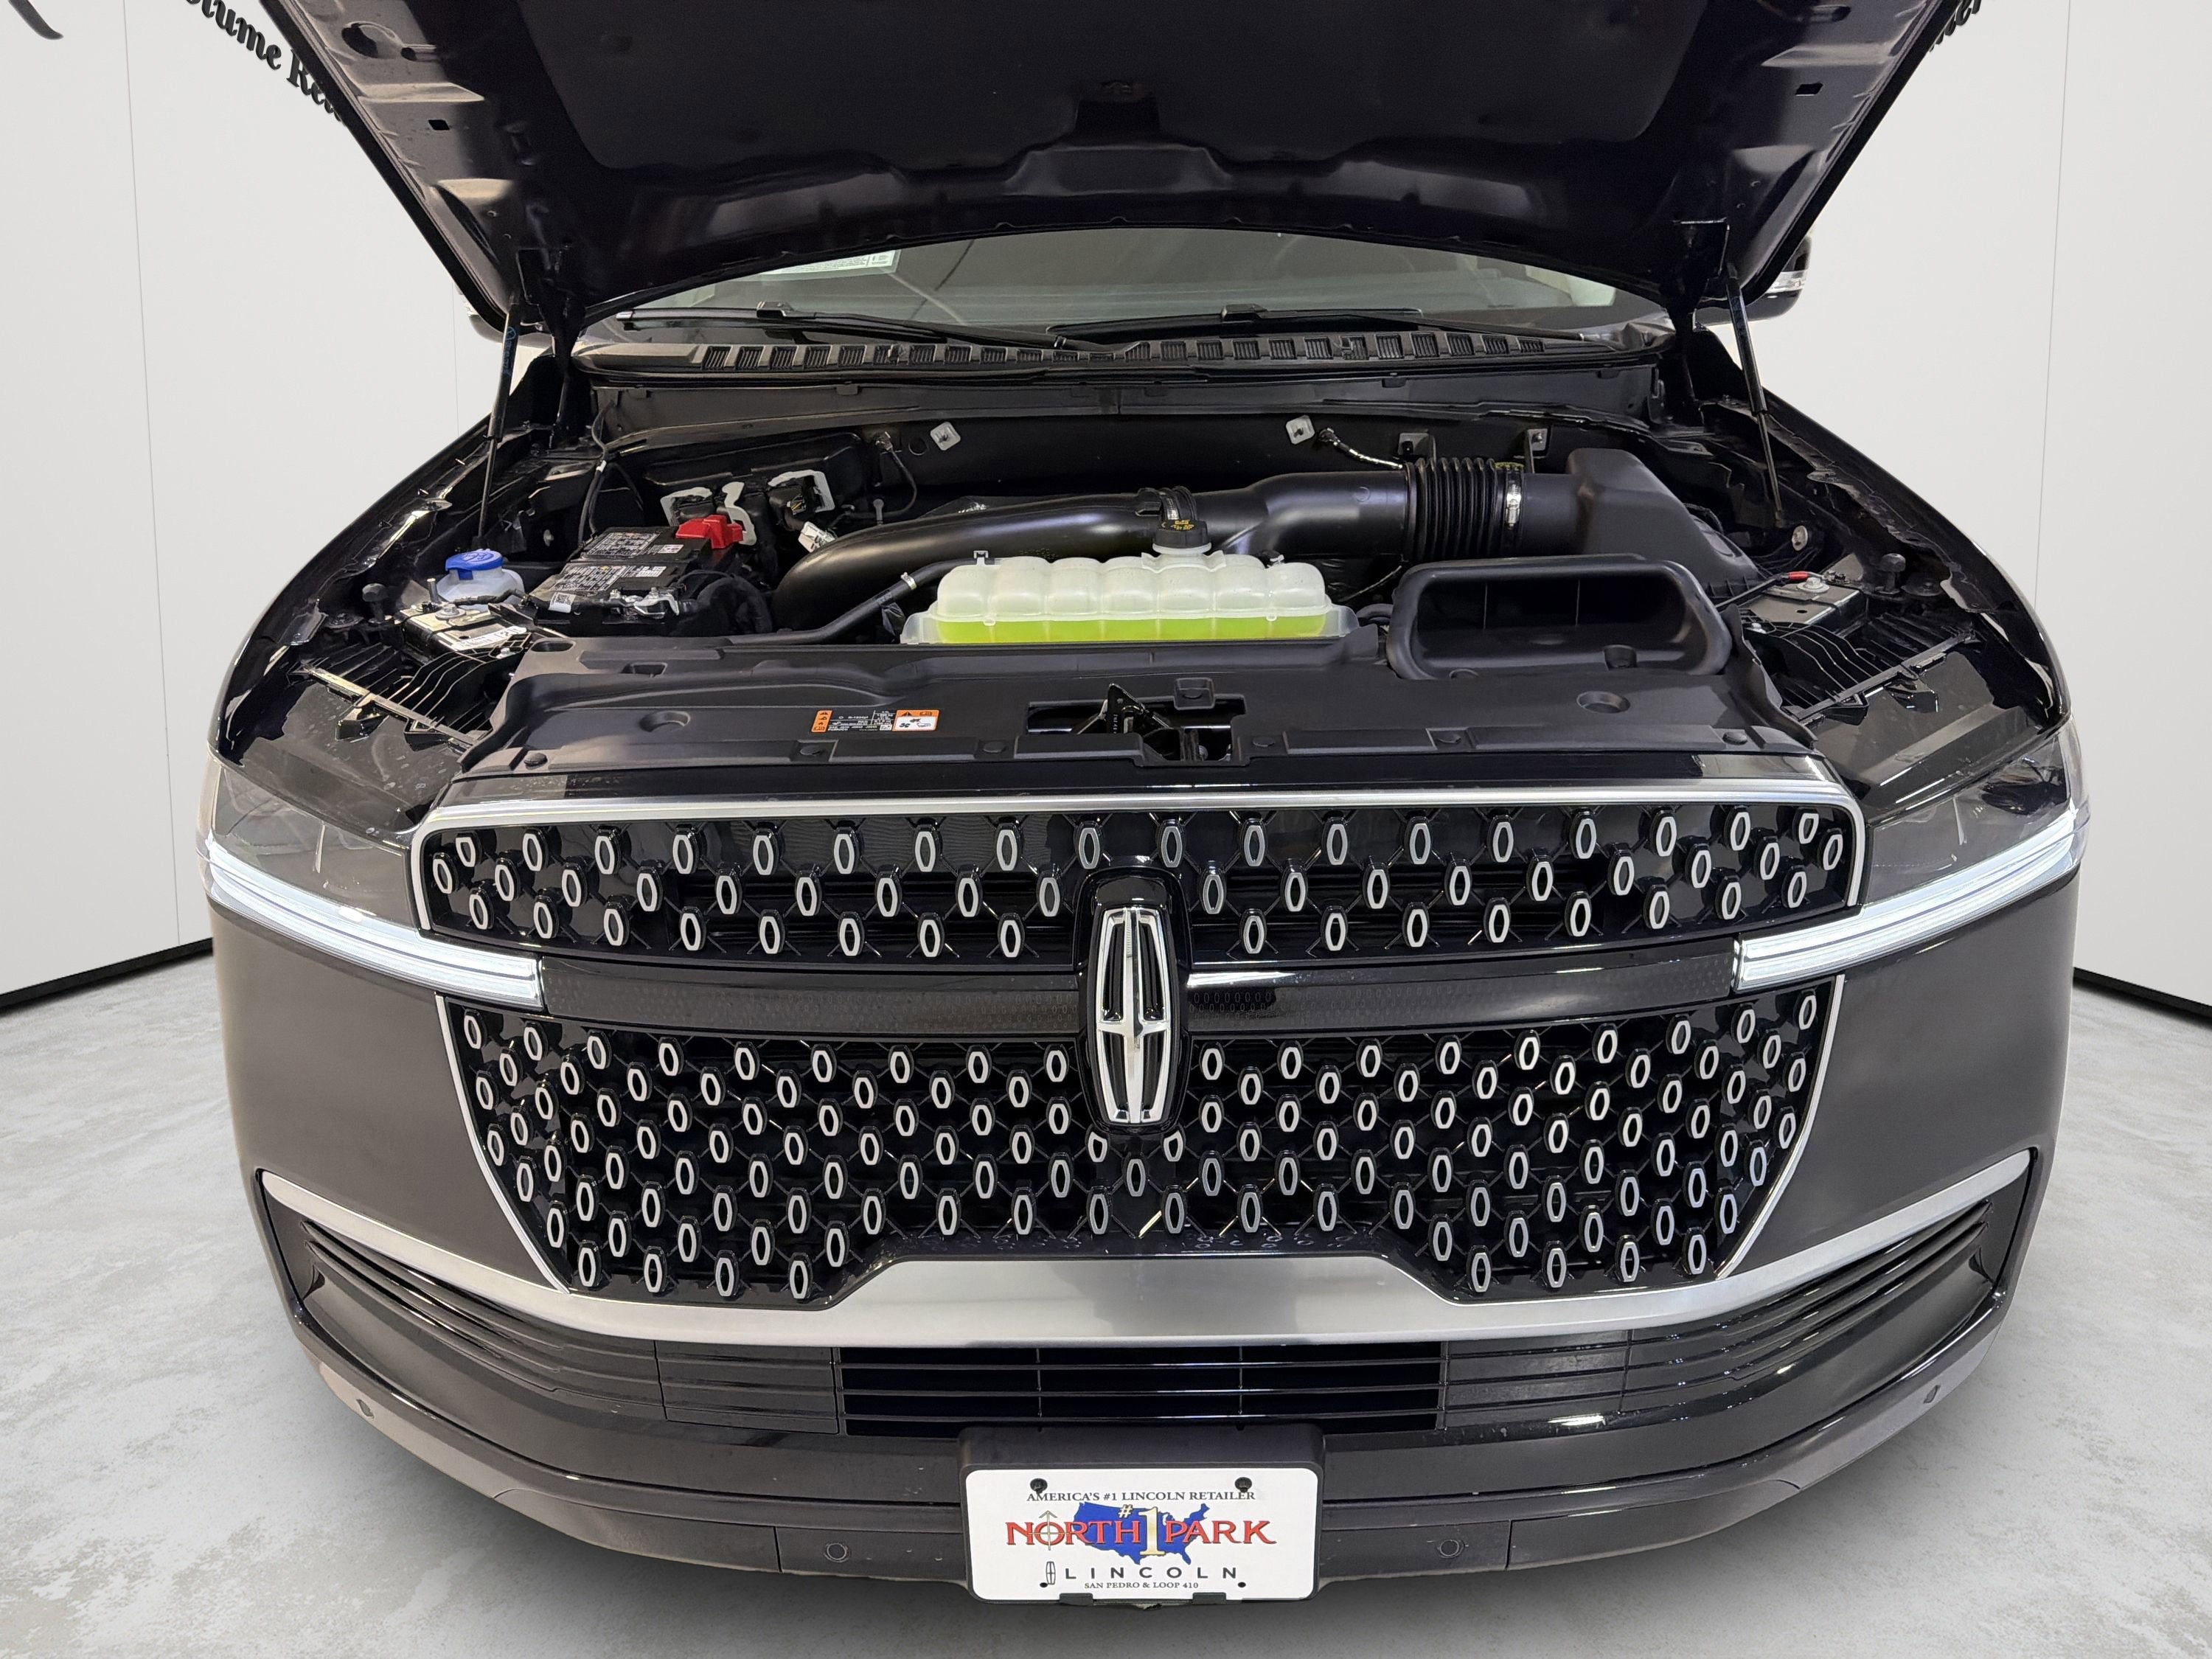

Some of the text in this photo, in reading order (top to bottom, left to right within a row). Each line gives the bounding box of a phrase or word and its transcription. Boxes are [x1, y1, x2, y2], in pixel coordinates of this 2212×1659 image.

[1026, 1492, 1256, 1501] AMERICA'S #1 LINCOLN RETAILER
[1005, 1520, 1277, 1545] NORTH PARK
[1065, 1566, 1237, 1580] LINCOLN
